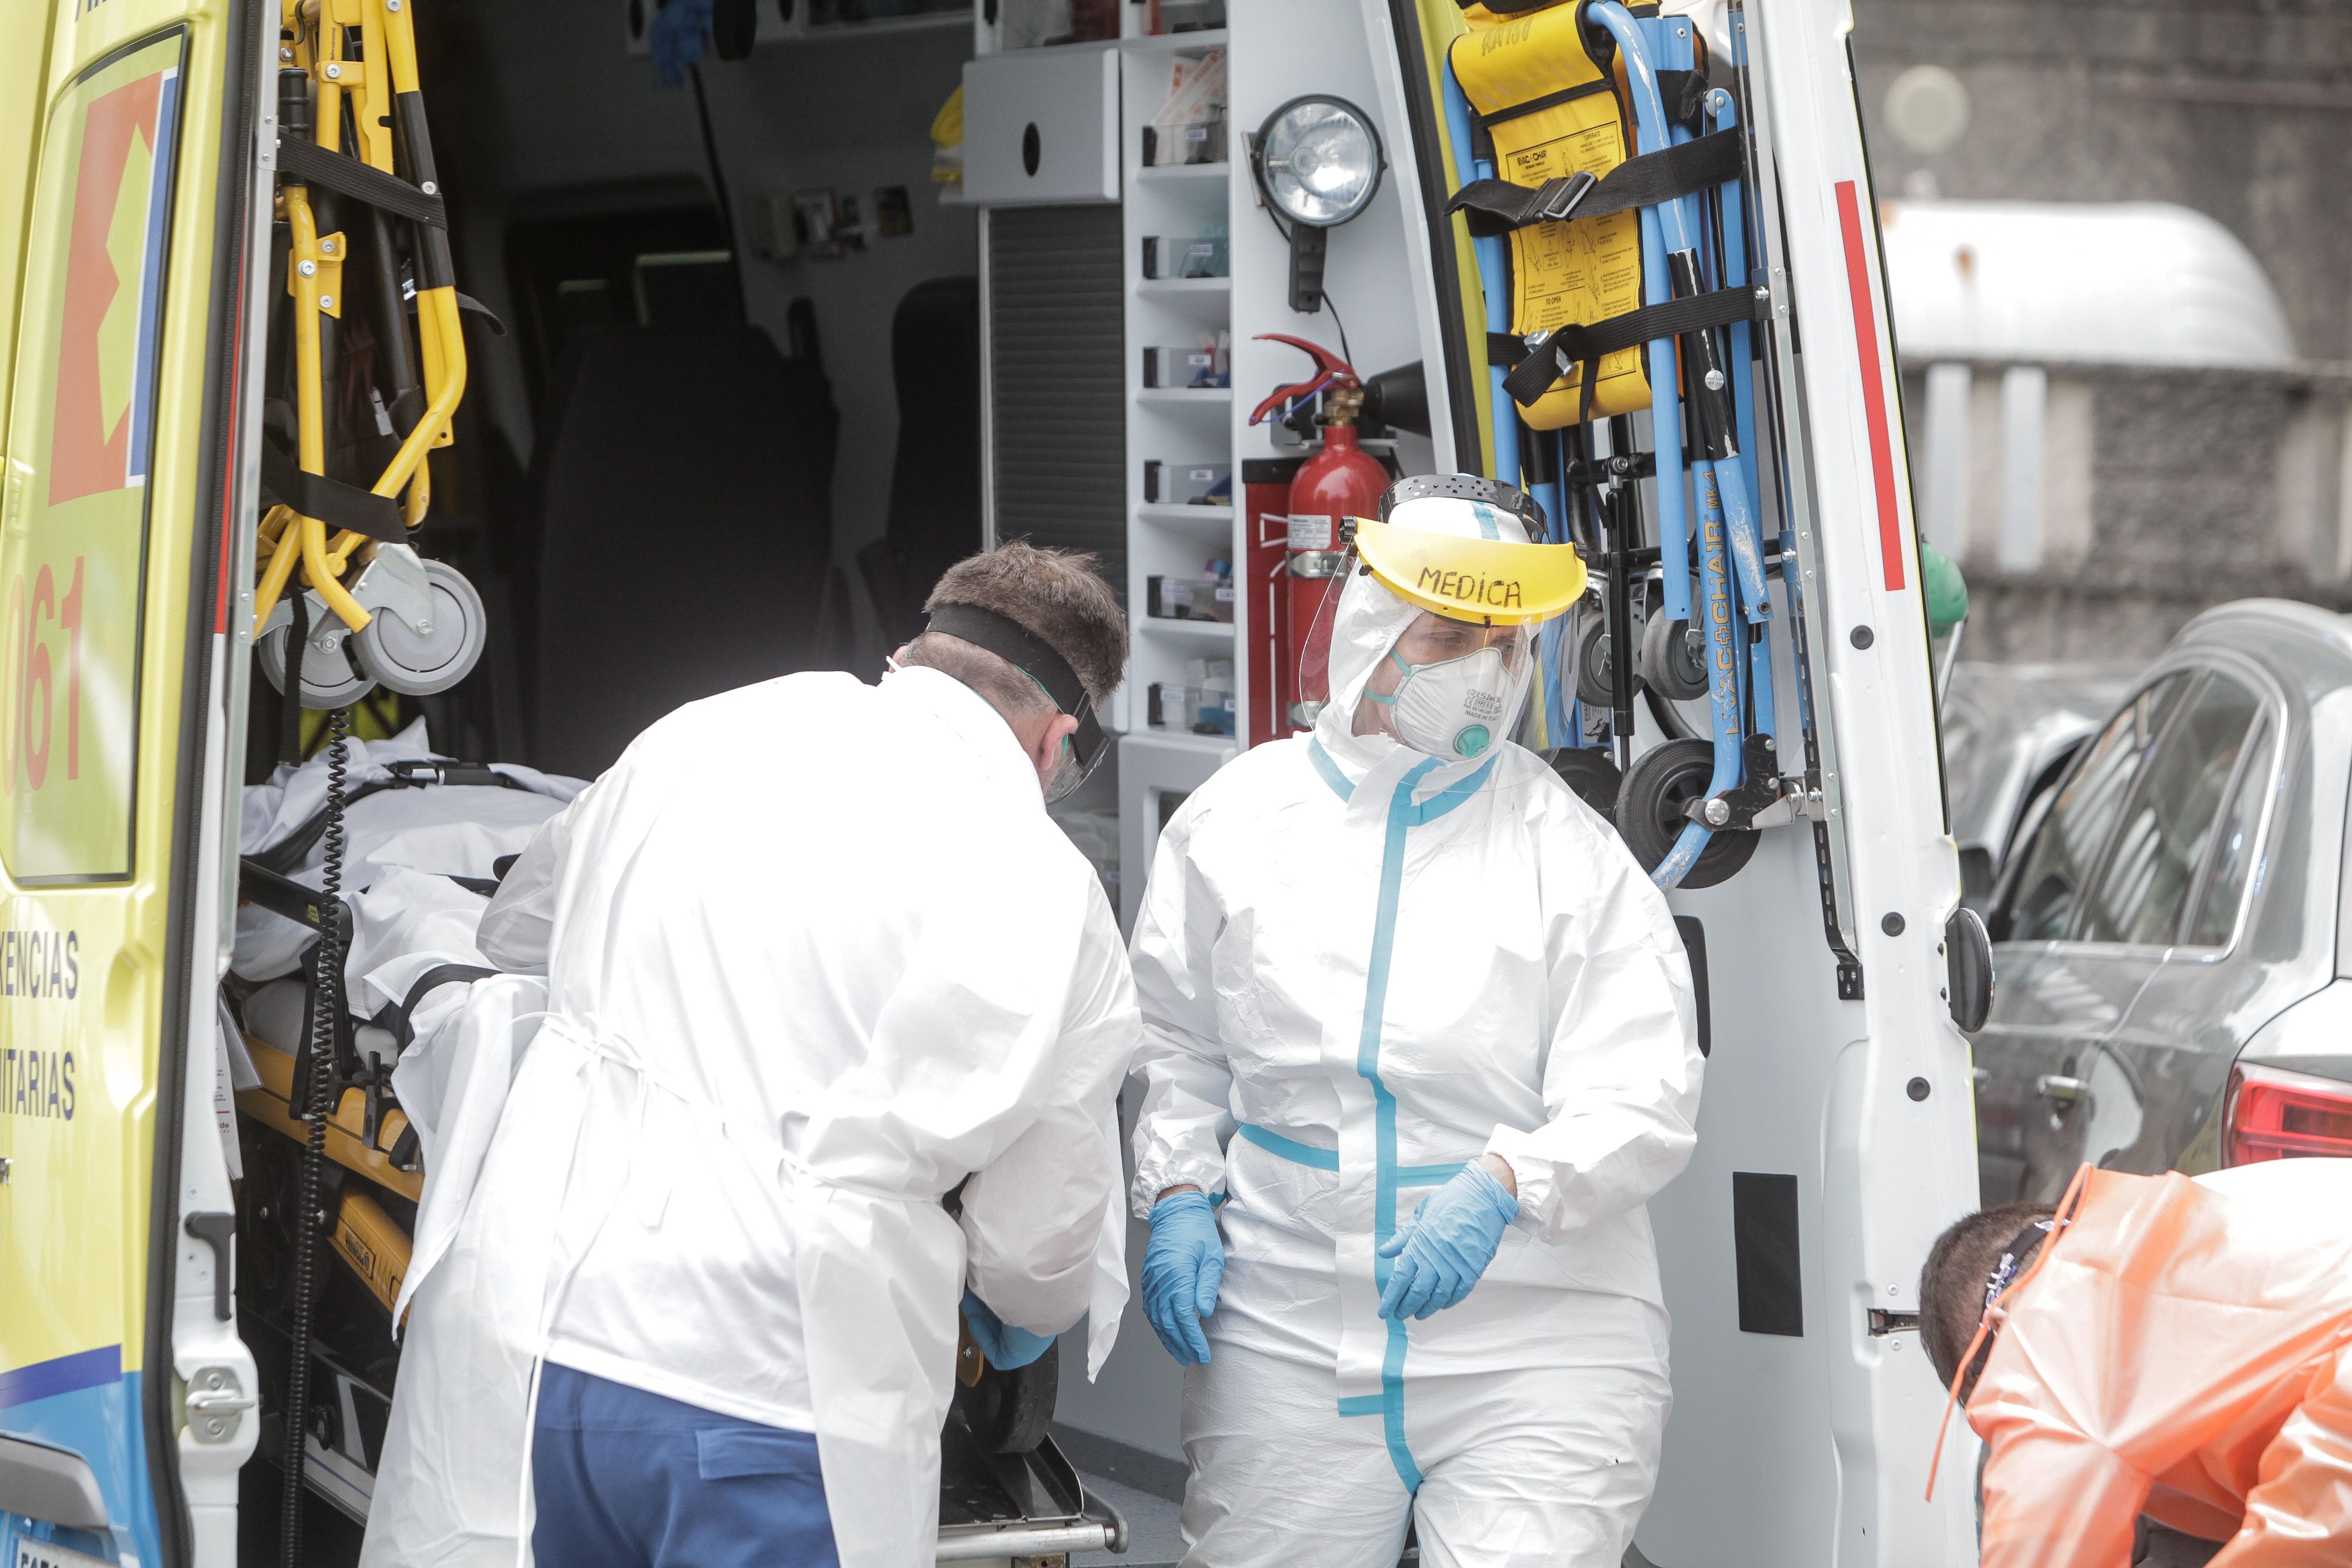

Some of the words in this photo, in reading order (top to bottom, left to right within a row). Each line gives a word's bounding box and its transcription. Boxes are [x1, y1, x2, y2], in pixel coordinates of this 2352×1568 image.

[1551, 296, 1562, 304] OPEN
[2, 556, 85, 796] 061
[1465, 710, 1481, 719] MADE
[0, 1048, 75, 1121] ITARIAS
